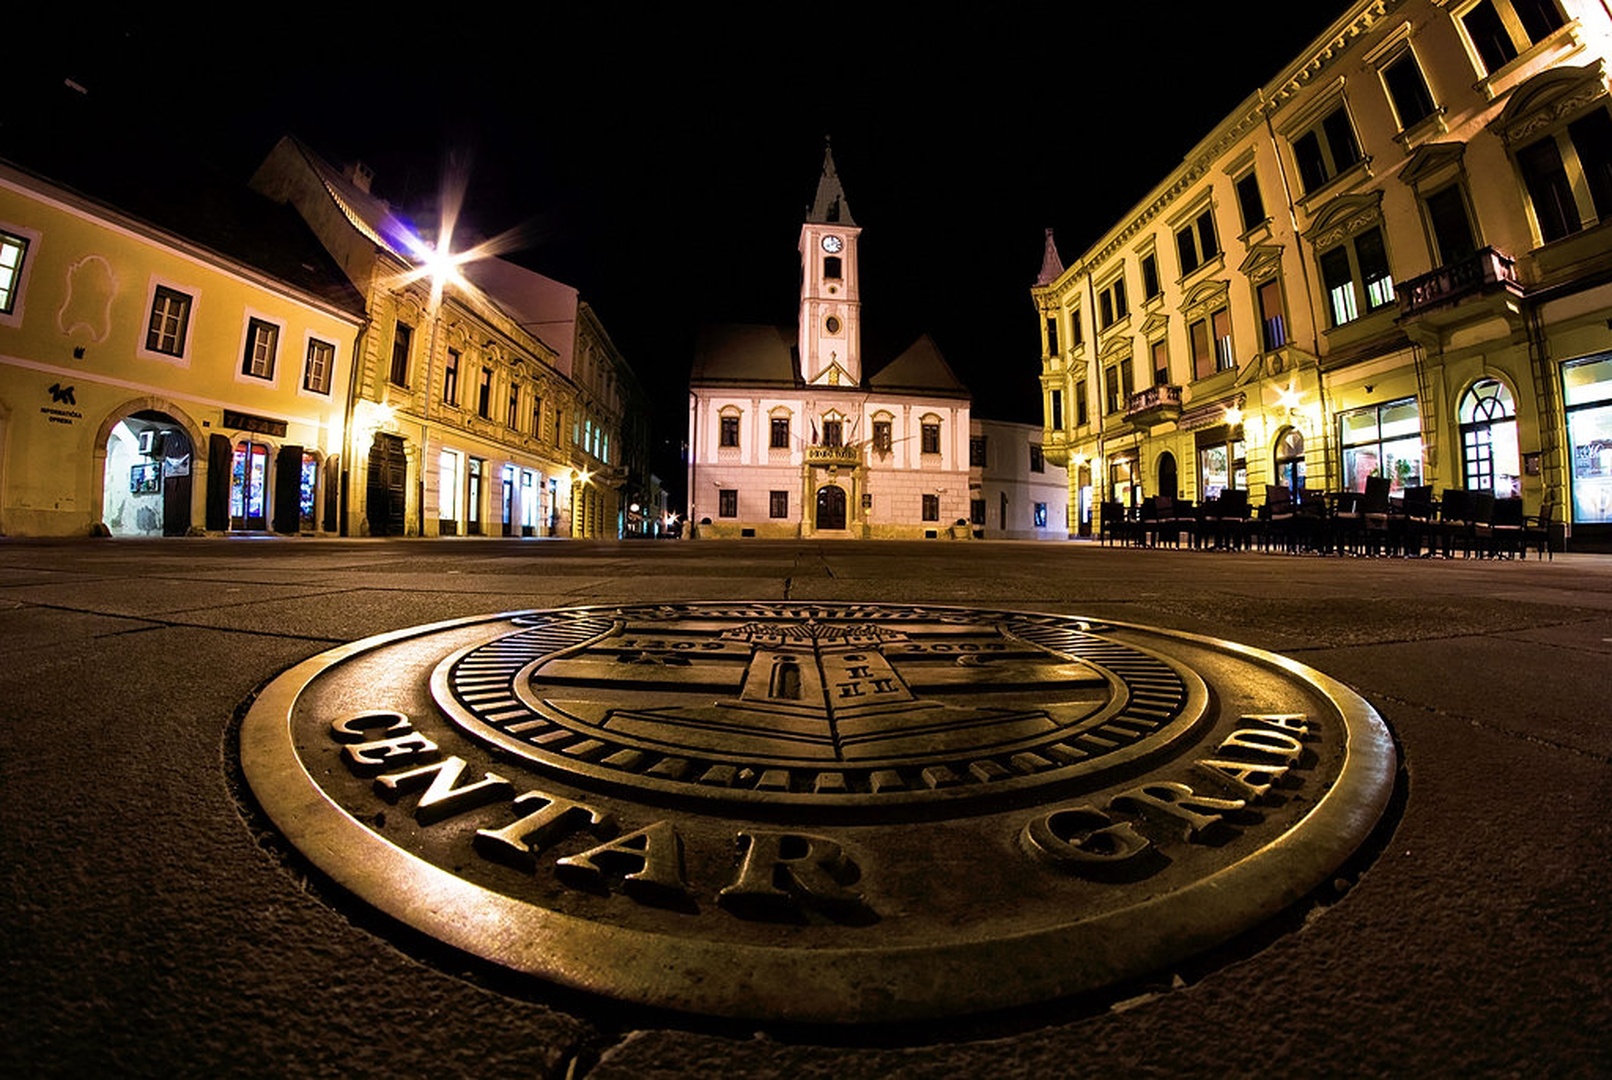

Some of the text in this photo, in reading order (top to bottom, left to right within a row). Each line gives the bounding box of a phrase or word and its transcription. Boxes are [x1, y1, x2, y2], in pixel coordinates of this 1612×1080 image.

[227, 414, 286, 435] TISAK
[331, 709, 1312, 912] CENTAR GRADA
